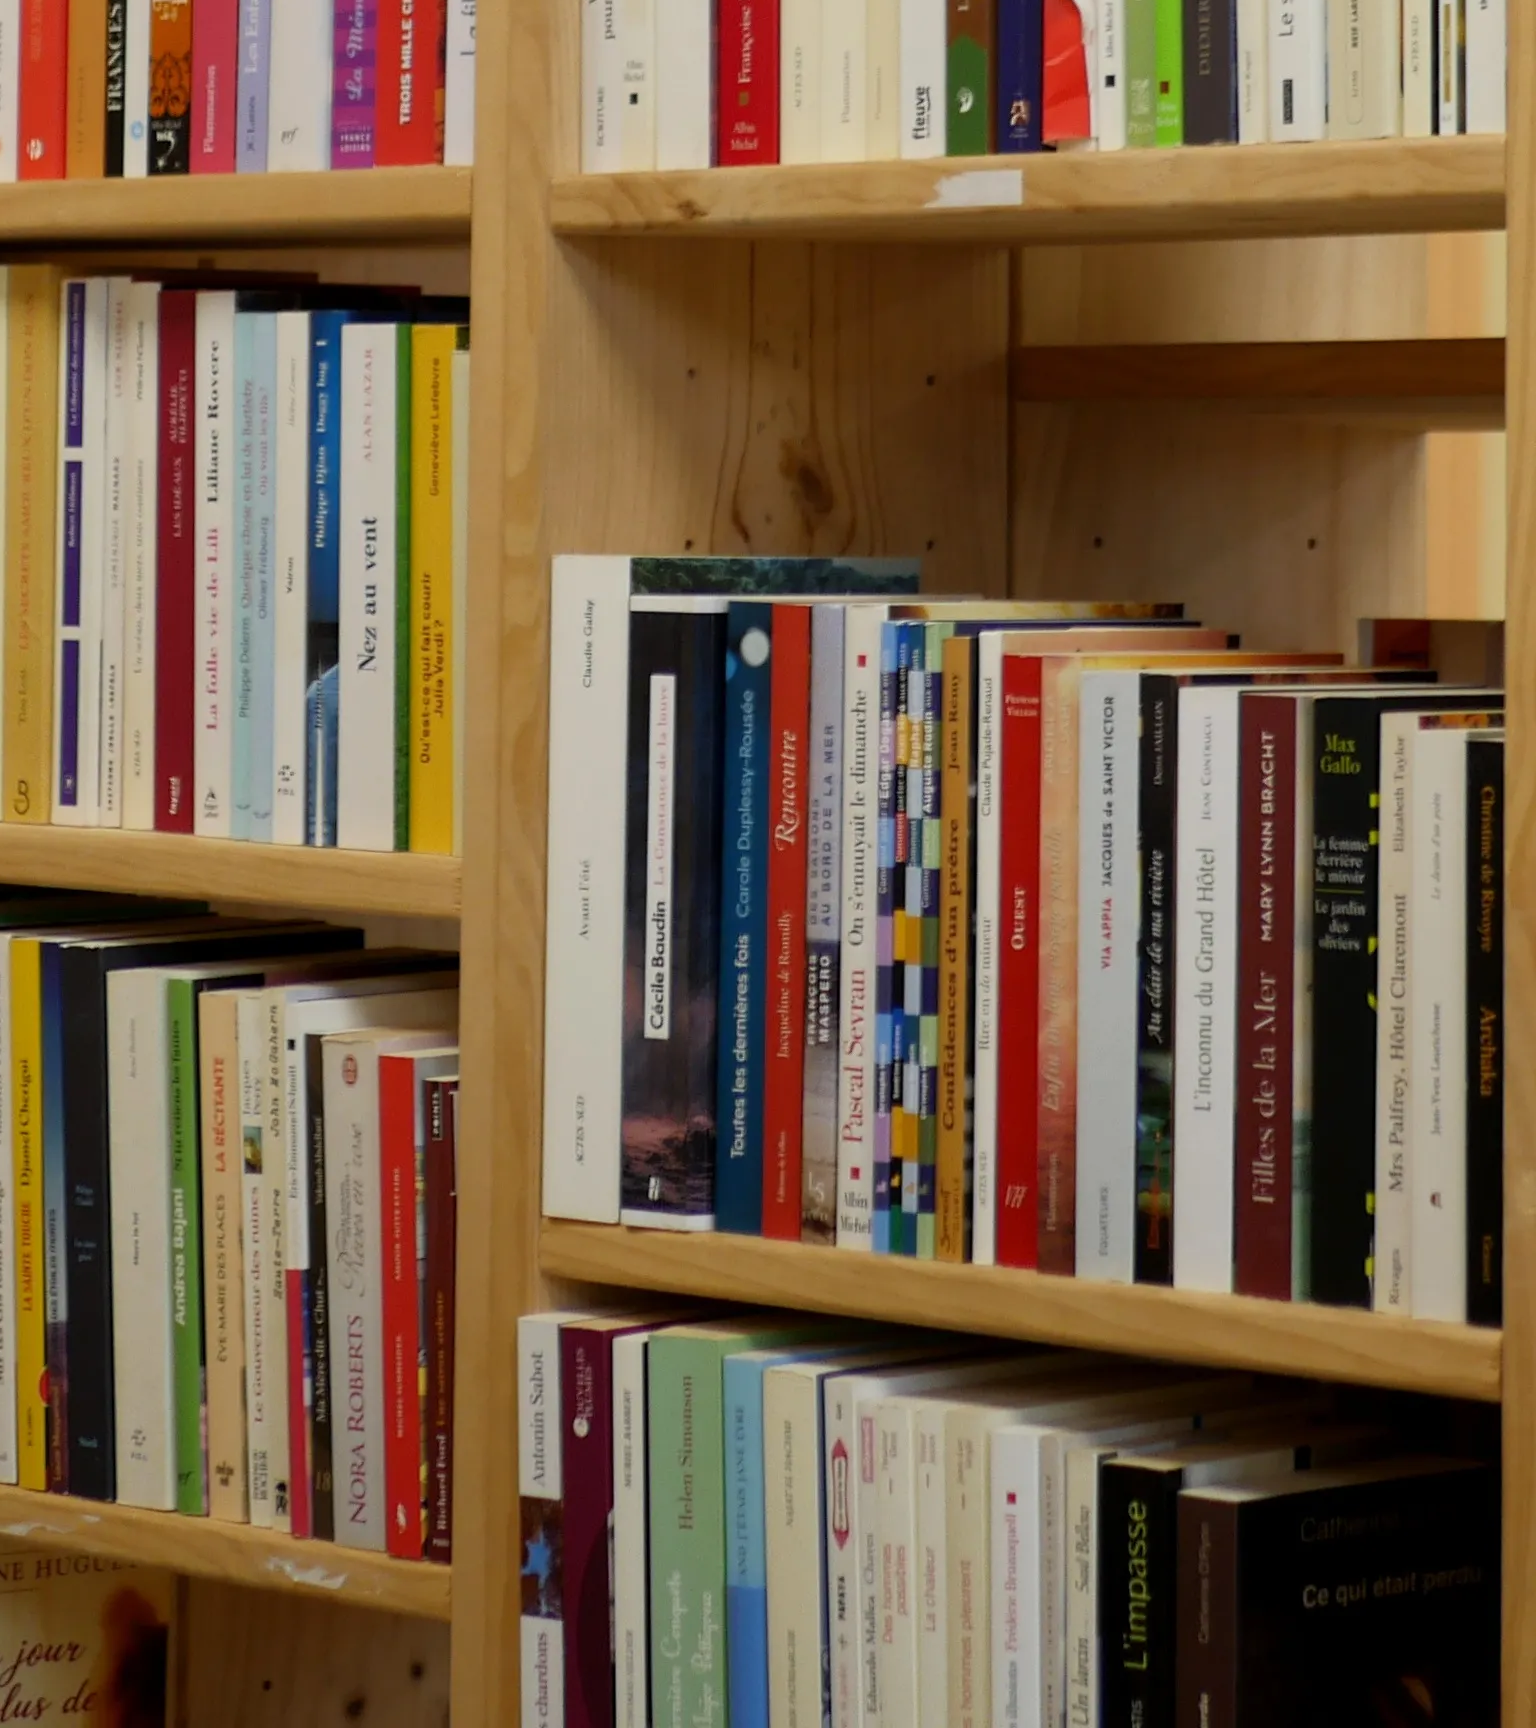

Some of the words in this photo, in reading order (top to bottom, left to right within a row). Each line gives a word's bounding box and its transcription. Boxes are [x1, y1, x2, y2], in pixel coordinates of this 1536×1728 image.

[1279, 12, 1293, 36] Le
[363, 515, 377, 571] vent
[363, 581, 377, 615] au
[359, 622, 377, 673] Nez
[774, 729, 797, 851] Rencontre
[1260, 731, 1275, 815] BRACHT
[1195, 847, 1214, 901] Hôtel
[1260, 821, 1273, 875] LYNN
[651, 900, 666, 969] Baudin
[1195, 903, 1214, 972] Grand
[1260, 883, 1273, 943] MARY
[735, 933, 750, 967] fois
[650, 973, 664, 1030] Cécile
[731, 972, 749, 1060] dernières
[844, 969, 865, 1057] Sevran
[1195, 981, 1213, 1007] du
[732, 1064, 747, 1096] les
[1194, 1017, 1212, 1112] L'inconnu
[730, 1101, 747, 1158] Toutes
[841, 1066, 863, 1144] Pascal
[346, 1314, 364, 1435] ROBERTS
[347, 1443, 366, 1525] NORA
[1124, 1499, 1152, 1671] L'impasse
[3, 1640, 87, 1688] jour
